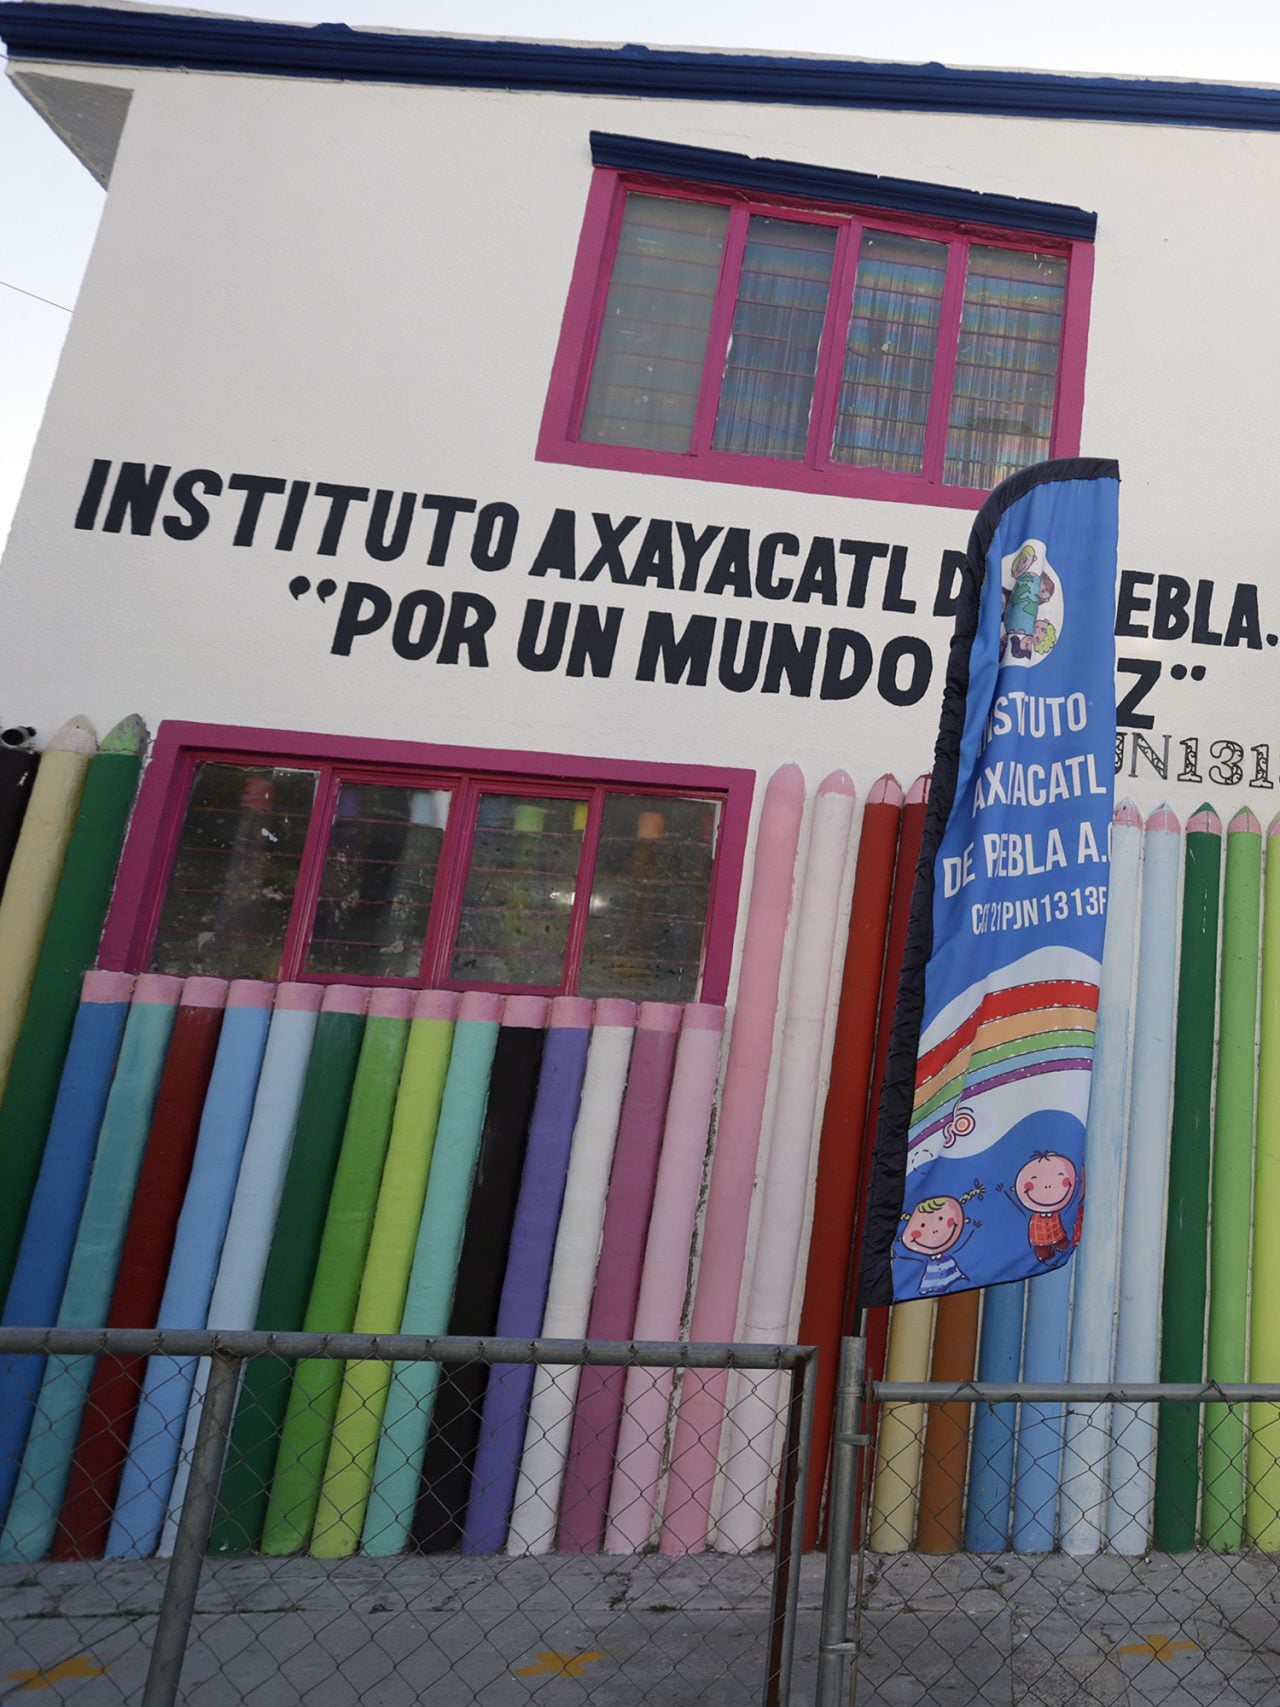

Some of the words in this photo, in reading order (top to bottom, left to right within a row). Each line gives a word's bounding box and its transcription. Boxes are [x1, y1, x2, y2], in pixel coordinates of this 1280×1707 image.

[74, 458, 519, 572] INSTITUTO
[528, 507, 917, 614] AXAYACATL
[934, 548, 967, 617] D
[517, 600, 625, 678] UN
[635, 611, 933, 707] MUNDO
[942, 841, 976, 899] DE
[983, 828, 1068, 879] PEBLA
